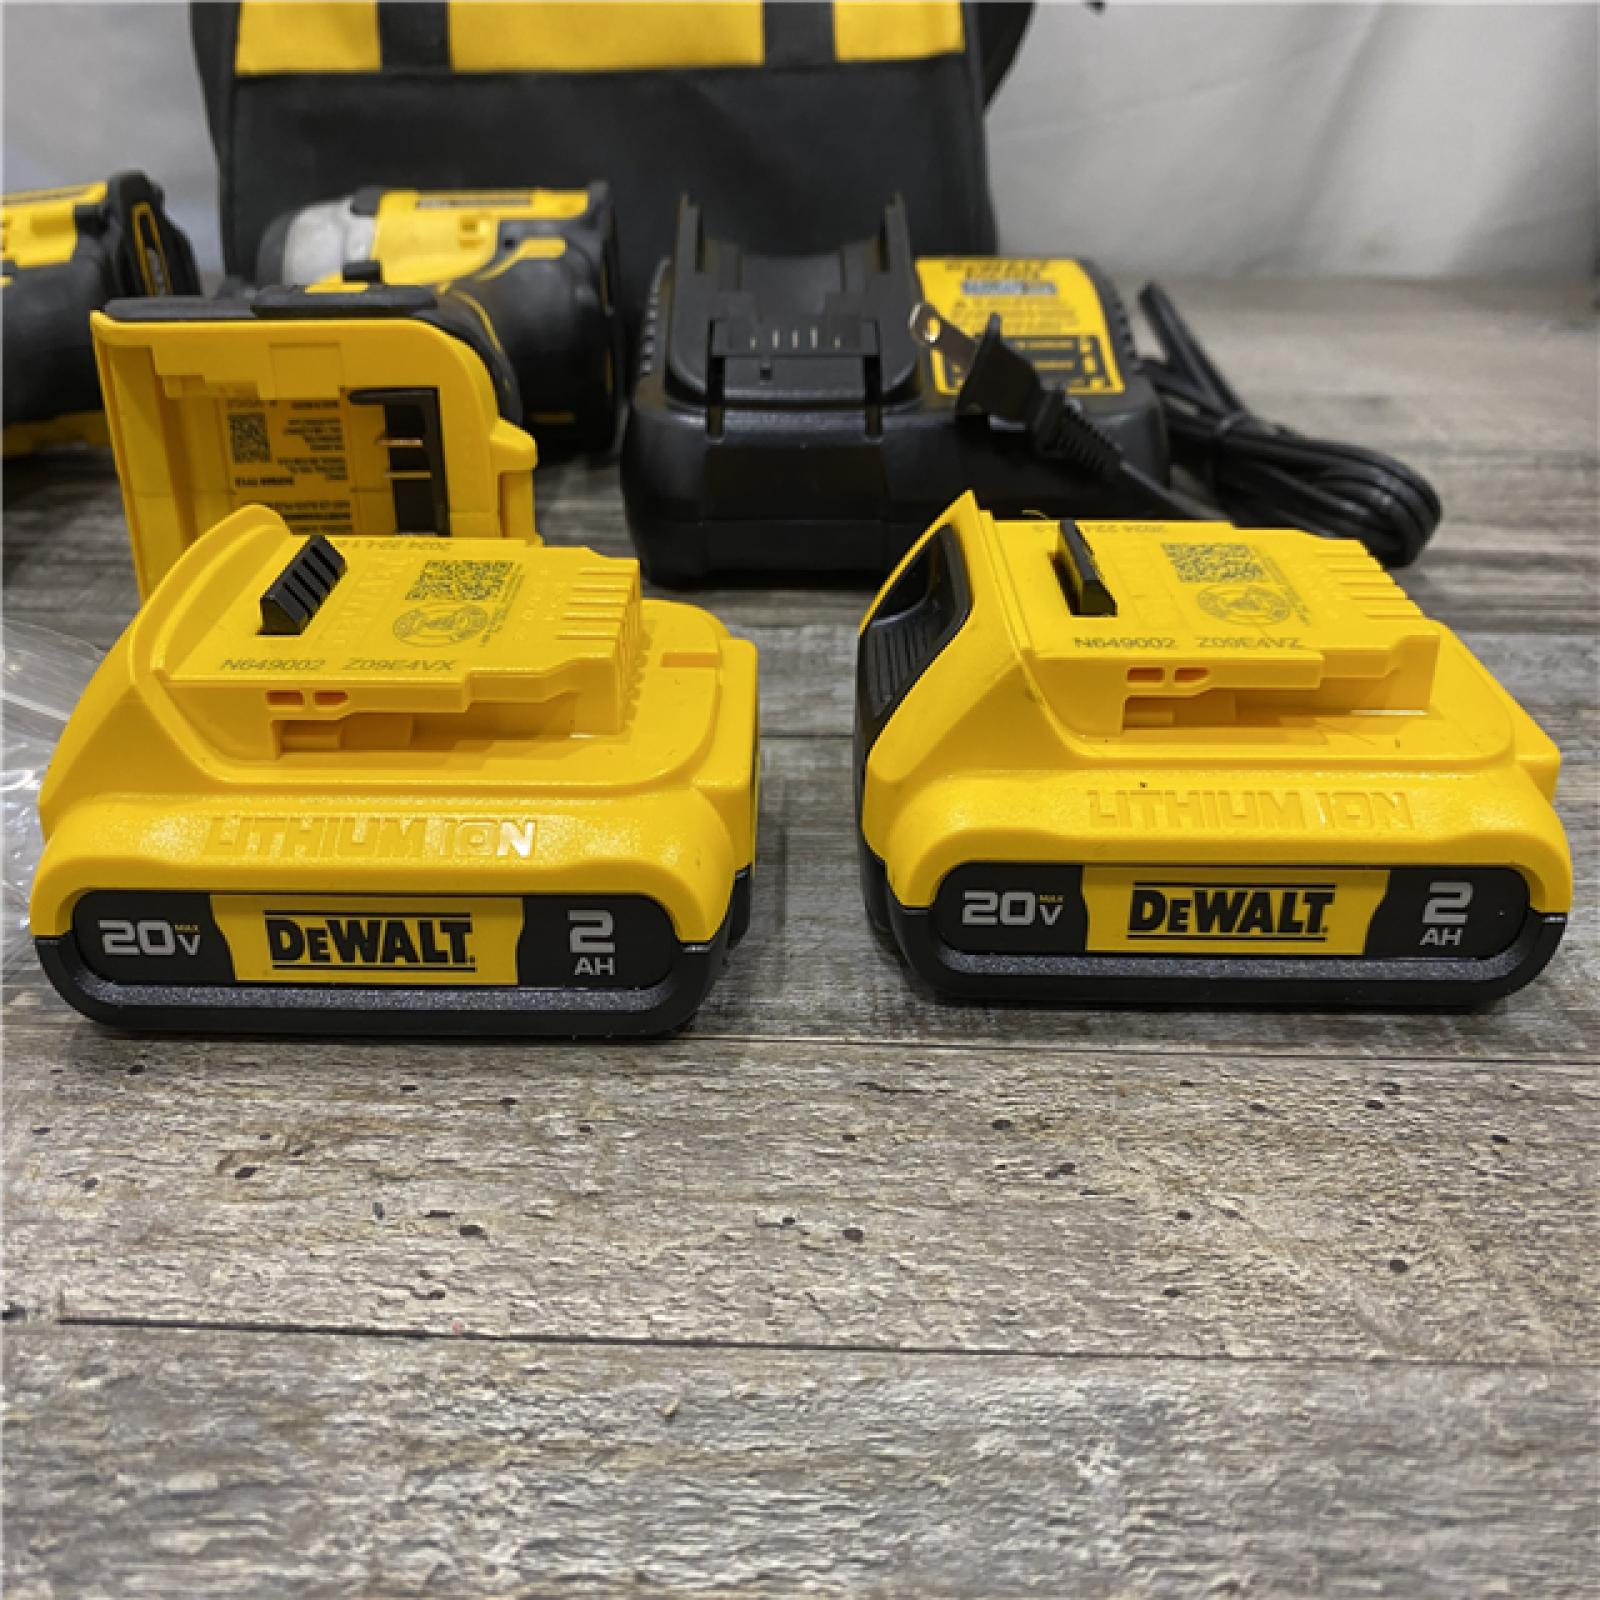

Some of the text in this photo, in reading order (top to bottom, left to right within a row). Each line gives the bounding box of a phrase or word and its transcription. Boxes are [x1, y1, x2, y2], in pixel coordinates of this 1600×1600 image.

[1086, 791, 1415, 829] LITHIUM ION
[202, 817, 537, 857] LITHIUM ION
[1422, 882, 1474, 923] 2
[567, 909, 616, 954] 2
[1420, 928, 1463, 947] AH
[573, 956, 616, 977] AH
